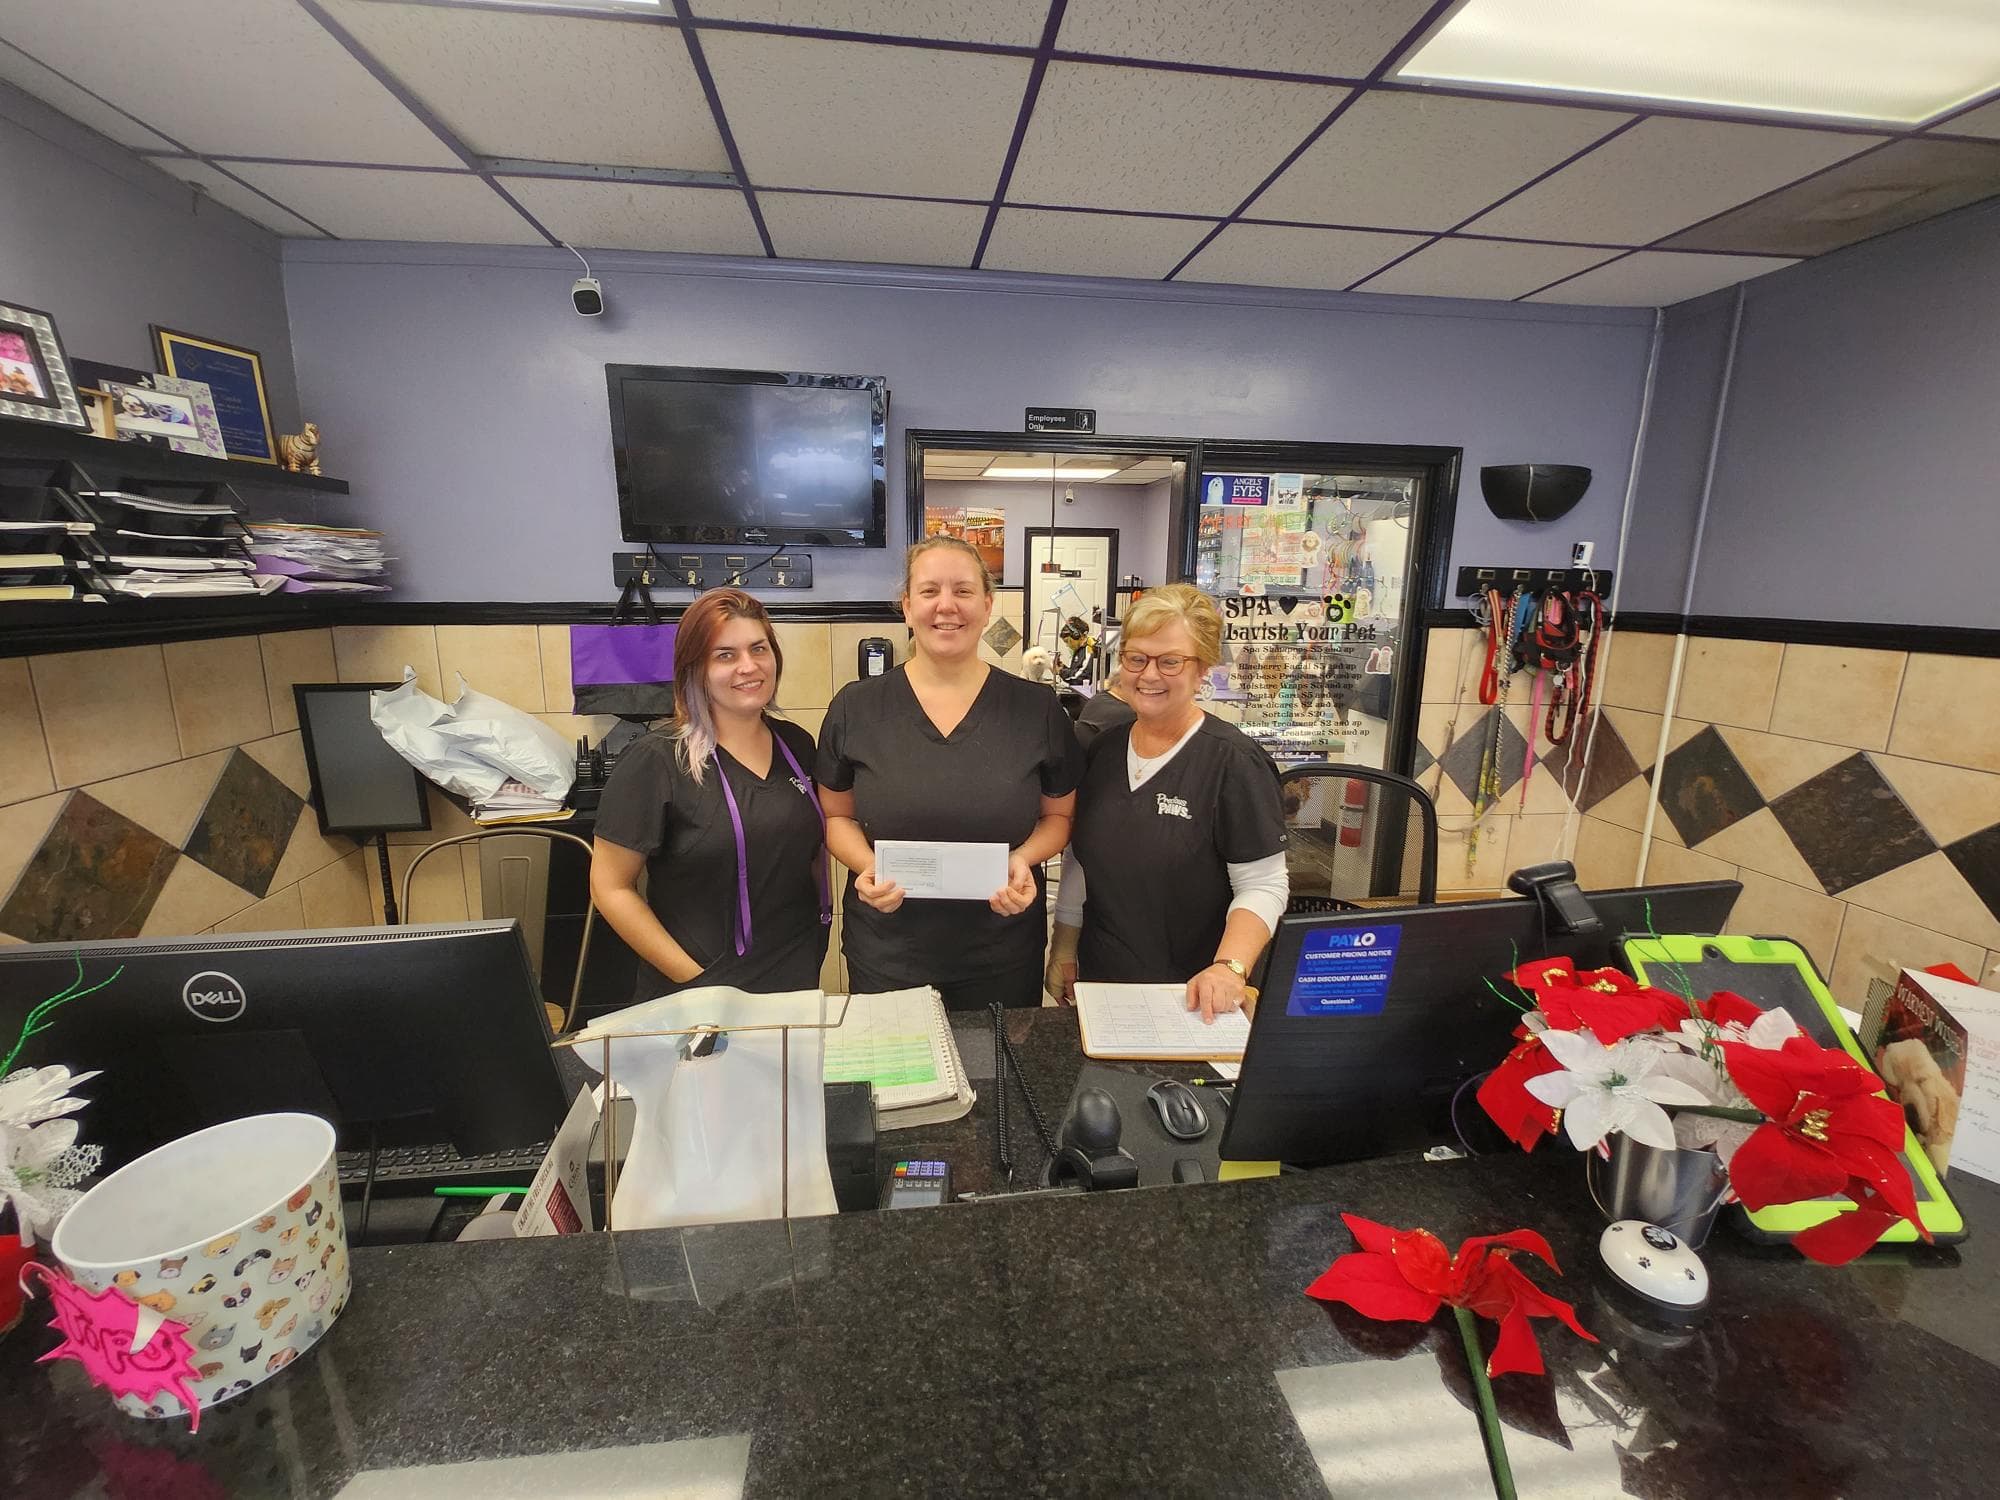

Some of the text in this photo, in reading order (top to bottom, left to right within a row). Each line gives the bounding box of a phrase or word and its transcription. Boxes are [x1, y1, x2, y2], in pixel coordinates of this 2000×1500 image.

[1028, 414, 1066, 423] Employees
[1028, 423, 1044, 431] Only
[1232, 485, 1262, 497] EYES
[1226, 595, 1272, 618] SPA
[1225, 622, 1377, 641] Lavish Your Pet
[1243, 645, 1260, 654] Spa
[1238, 662, 1281, 671] Blueberry
[1240, 682, 1278, 690] Moisture
[1280, 682, 1308, 690] Wraps
[1262, 710, 1305, 718] Softclaws
[1246, 720, 1270, 728] Stain
[1271, 720, 1318, 728] Treatment
[1320, 719, 1332, 727] $2
[1280, 729, 1326, 737] Treatment
[1328, 728, 1340, 736] $5
[1341, 728, 1357, 736] and
[1329, 932, 1376, 947] PAYLO
[1305, 952, 1341, 960] CUSTOMER
[1368, 949, 1393, 957] NOTICE
[190, 990, 241, 1005] DELL
[1896, 983, 1935, 1029] WARMEST
[518, 1208, 529, 1231] ENJOY
[526, 1197, 535, 1210] THE
[533, 1183, 542, 1199] FREE
